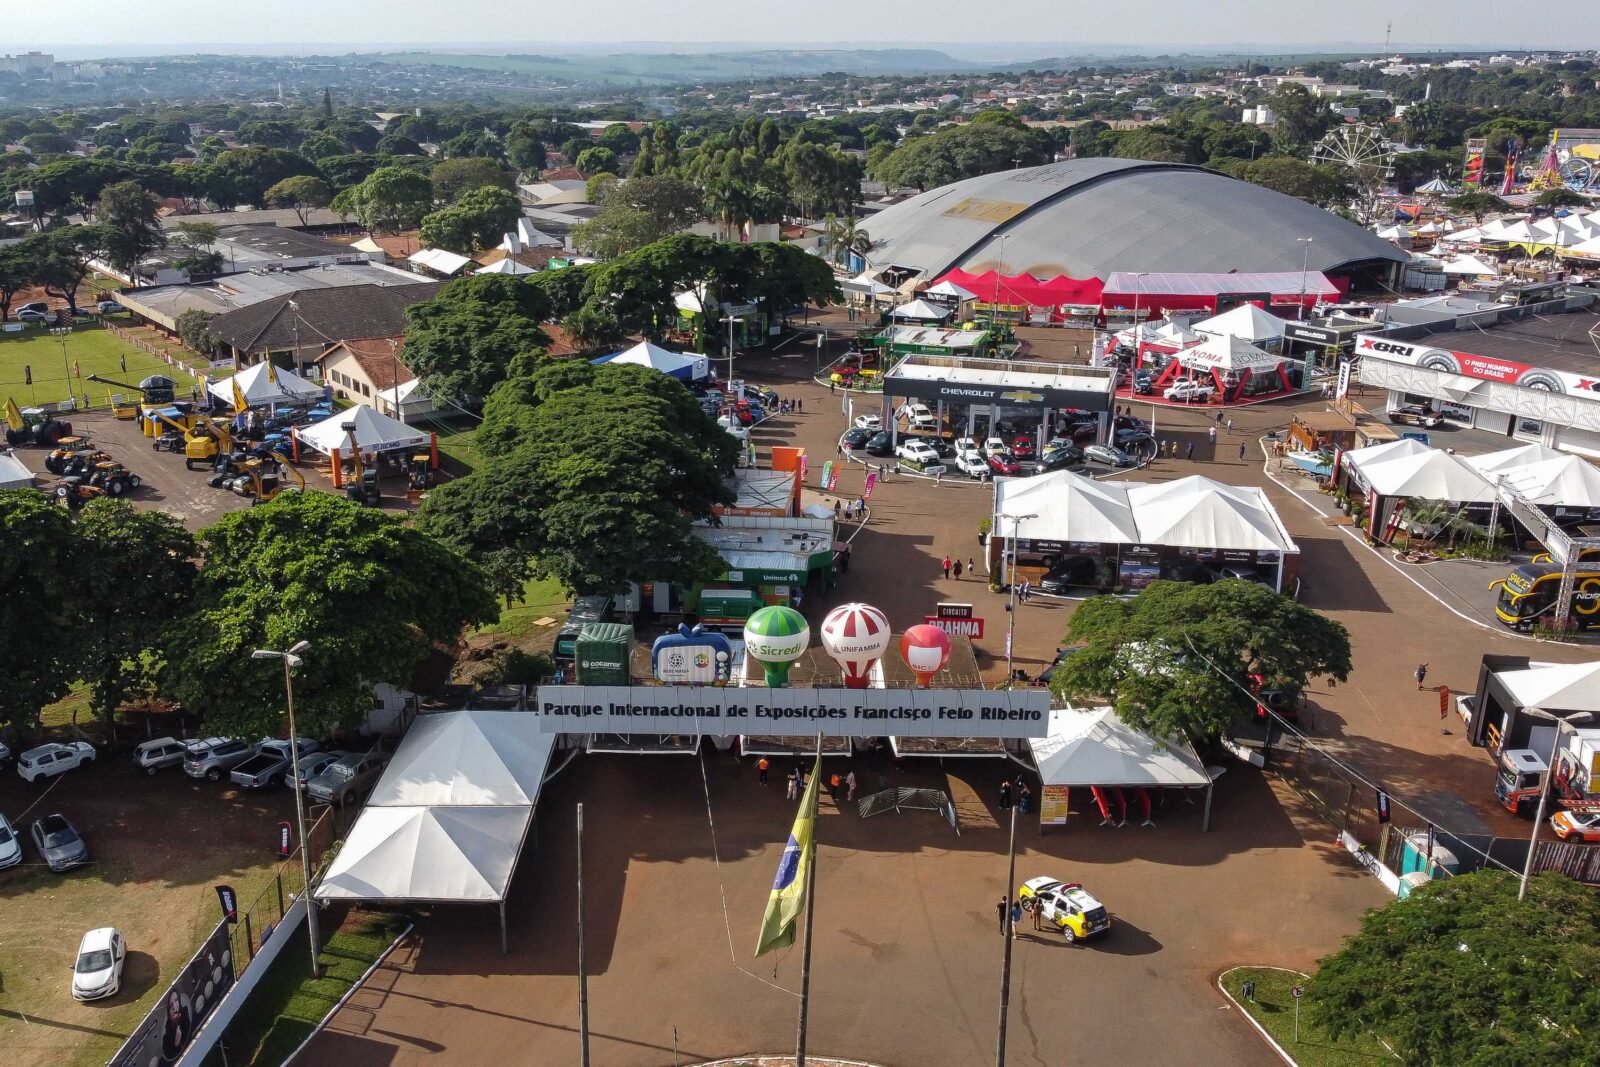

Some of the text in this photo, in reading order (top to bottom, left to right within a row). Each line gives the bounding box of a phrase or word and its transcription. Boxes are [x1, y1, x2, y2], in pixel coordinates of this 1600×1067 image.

[1360, 339, 1415, 357] XBRI
[1190, 349, 1223, 363] NOMA
[1232, 352, 1270, 365] NOMA
[1471, 360, 1488, 369] PNEU
[1472, 366, 1505, 379] DO BRASIL
[940, 387, 996, 398] CHEVROLET
[1508, 573, 1529, 590] SPACE
[942, 607, 968, 616] CIRCUITO
[760, 644, 801, 656] Sicredi
[841, 642, 881, 654] UNIFAMMA
[694, 654, 709, 665] sbt
[543, 702, 603, 718] Parque
[609, 703, 721, 718] Internacional
[725, 704, 749, 718] de
[755, 704, 847, 721] Exposições
[938, 706, 973, 720] Feio
[980, 706, 1042, 721] Ribeiro
